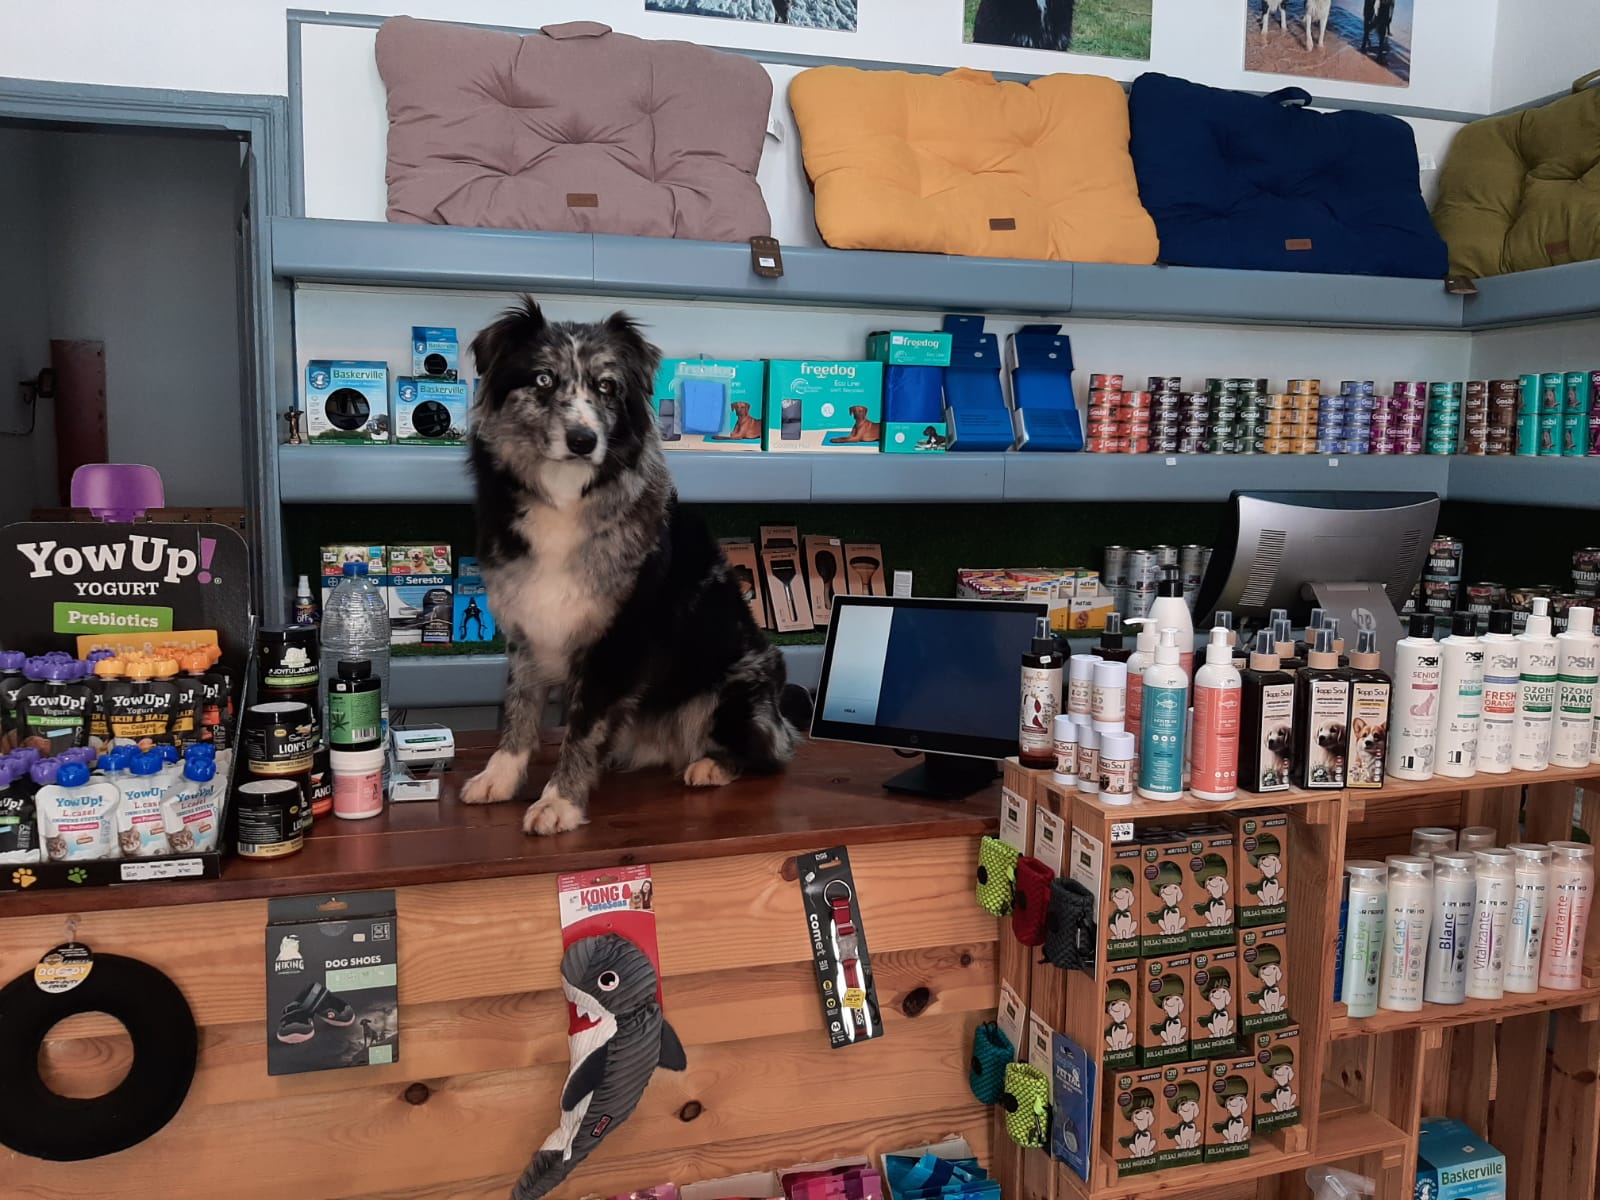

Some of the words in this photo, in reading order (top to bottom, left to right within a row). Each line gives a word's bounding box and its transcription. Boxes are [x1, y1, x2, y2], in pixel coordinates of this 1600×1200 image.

[903, 337, 940, 349] freedog
[333, 369, 384, 379] Baskerville
[801, 362, 856, 378] freedog
[420, 385, 465, 395] Baskerville
[16, 534, 217, 584] YowUp!
[1428, 558, 1455, 567] JUNIOR
[406, 576, 444, 584] Seresto
[73, 582, 159, 596] YOGURT
[1425, 599, 1451, 608] JUNIOR
[67, 610, 159, 628] Prebiotics
[1356, 610, 1373, 629] hp
[1418, 656, 1439, 666] PSH
[1465, 651, 1484, 661] PSH
[1491, 655, 1518, 668] PSH
[1529, 655, 1556, 666] PSH
[1567, 655, 1595, 668] PSH
[1333, 686, 1347, 694] Soul
[1374, 687, 1388, 696] Soul
[1485, 690, 1516, 700] FRESH
[27, 695, 86, 710] YowUp!
[112, 693, 171, 708] YowUp!
[1561, 694, 1593, 703] HARD
[42, 707, 70, 716] Yogurt
[279, 742, 306, 754] LION'S
[56, 795, 103, 807] YowUp!
[580, 886, 619, 905] KONG
[1512, 896, 1527, 925] Baby
[1440, 912, 1454, 950] Blanc
[1552, 895, 1568, 958] Hidratante
[810, 913, 826, 956] comet
[1474, 911, 1490, 970] Vitalizante
[274, 959, 305, 971] HIKING
[325, 958, 348, 968] DOG
[350, 955, 382, 966] SHOES
[1441, 1163, 1502, 1185] Baskerville
